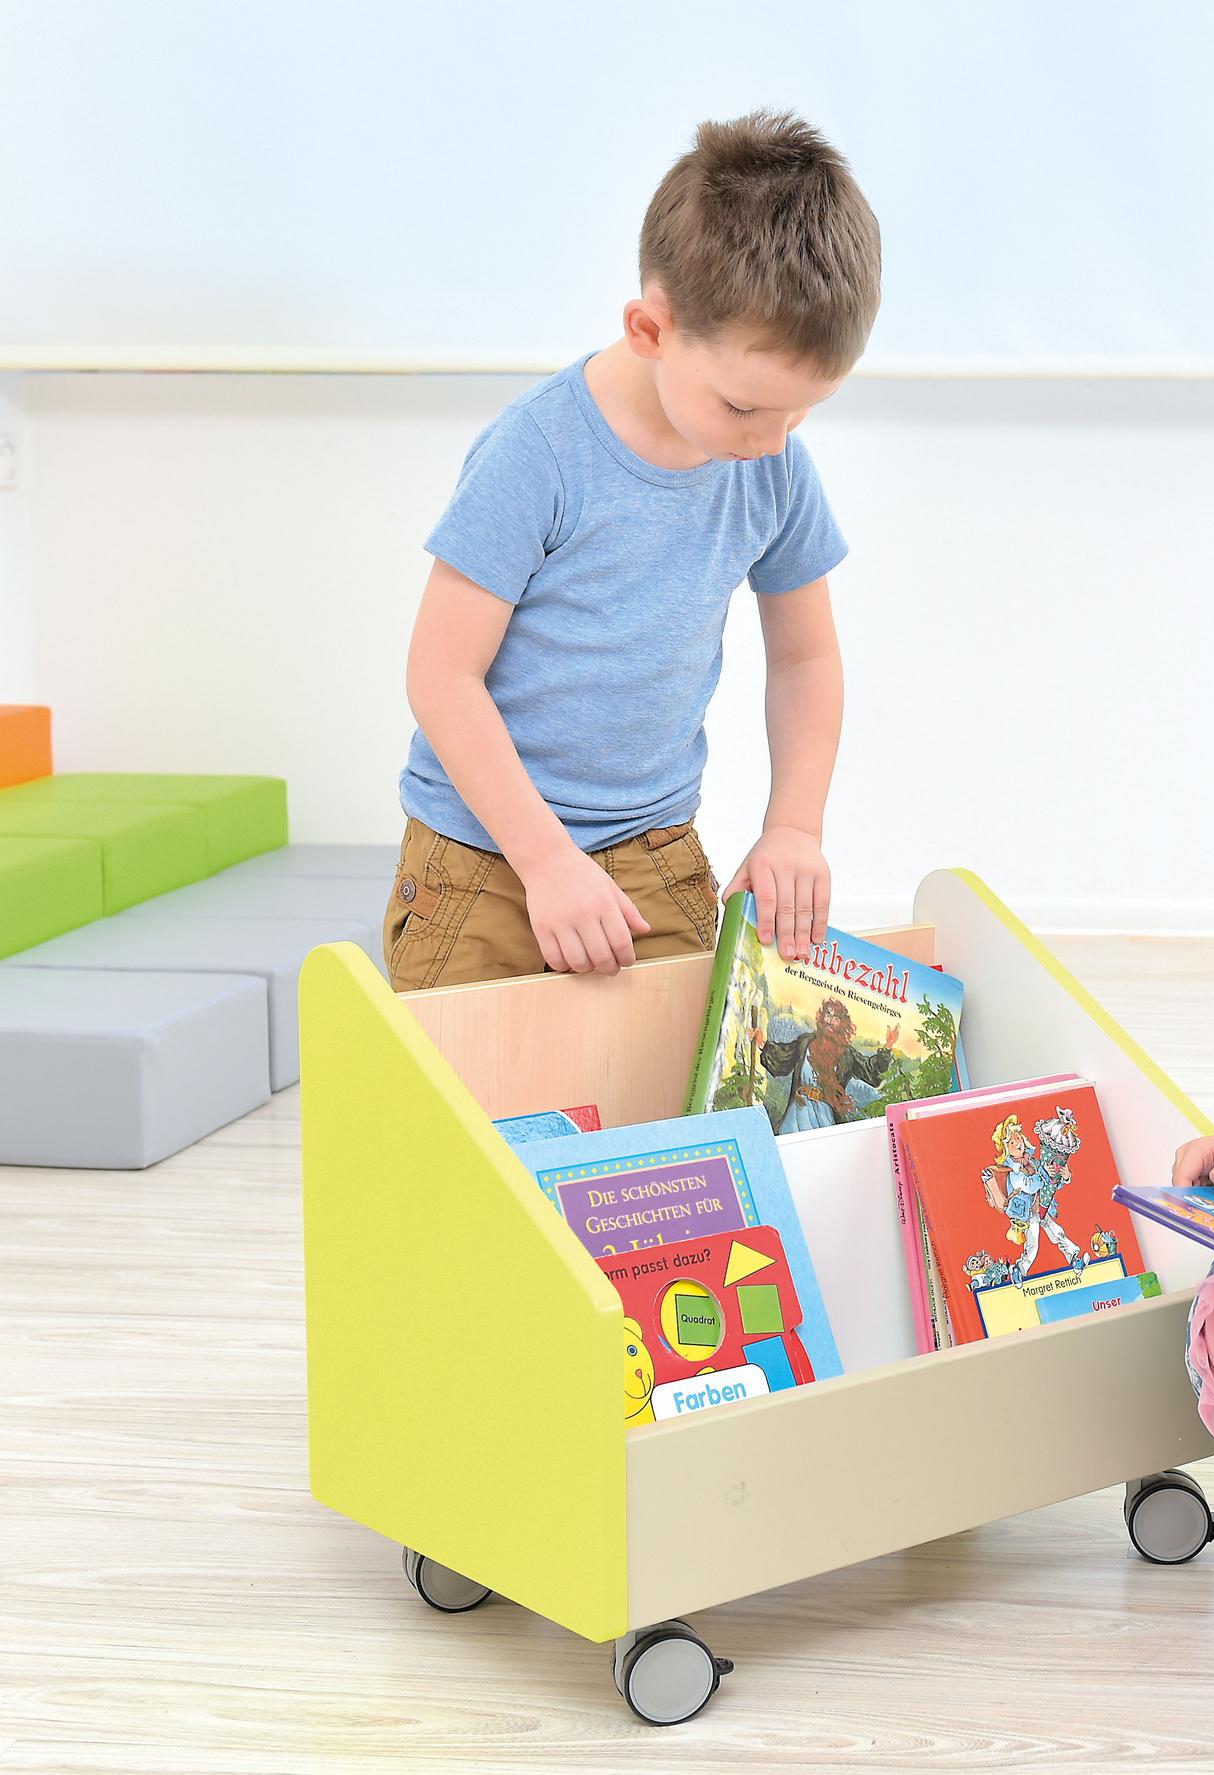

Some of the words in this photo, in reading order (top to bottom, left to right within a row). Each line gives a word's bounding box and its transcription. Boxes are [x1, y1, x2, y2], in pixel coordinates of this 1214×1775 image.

[794, 941, 909, 1003] übezahl
[784, 965, 798, 977] der
[799, 970, 833, 992] Berggeist
[833, 985, 846, 996] des
[847, 989, 902, 1019] Riesengebirges
[603, 1267, 628, 1281] orm
[632, 1257, 669, 1279] passt
[673, 1248, 711, 1270] dazu?
[1022, 1281, 1054, 1298] Margret
[1053, 1275, 1082, 1291] Rettich
[681, 1313, 716, 1326] Quadrat
[1092, 1296, 1121, 1312] Unser
[673, 1380, 747, 1414] Farben
